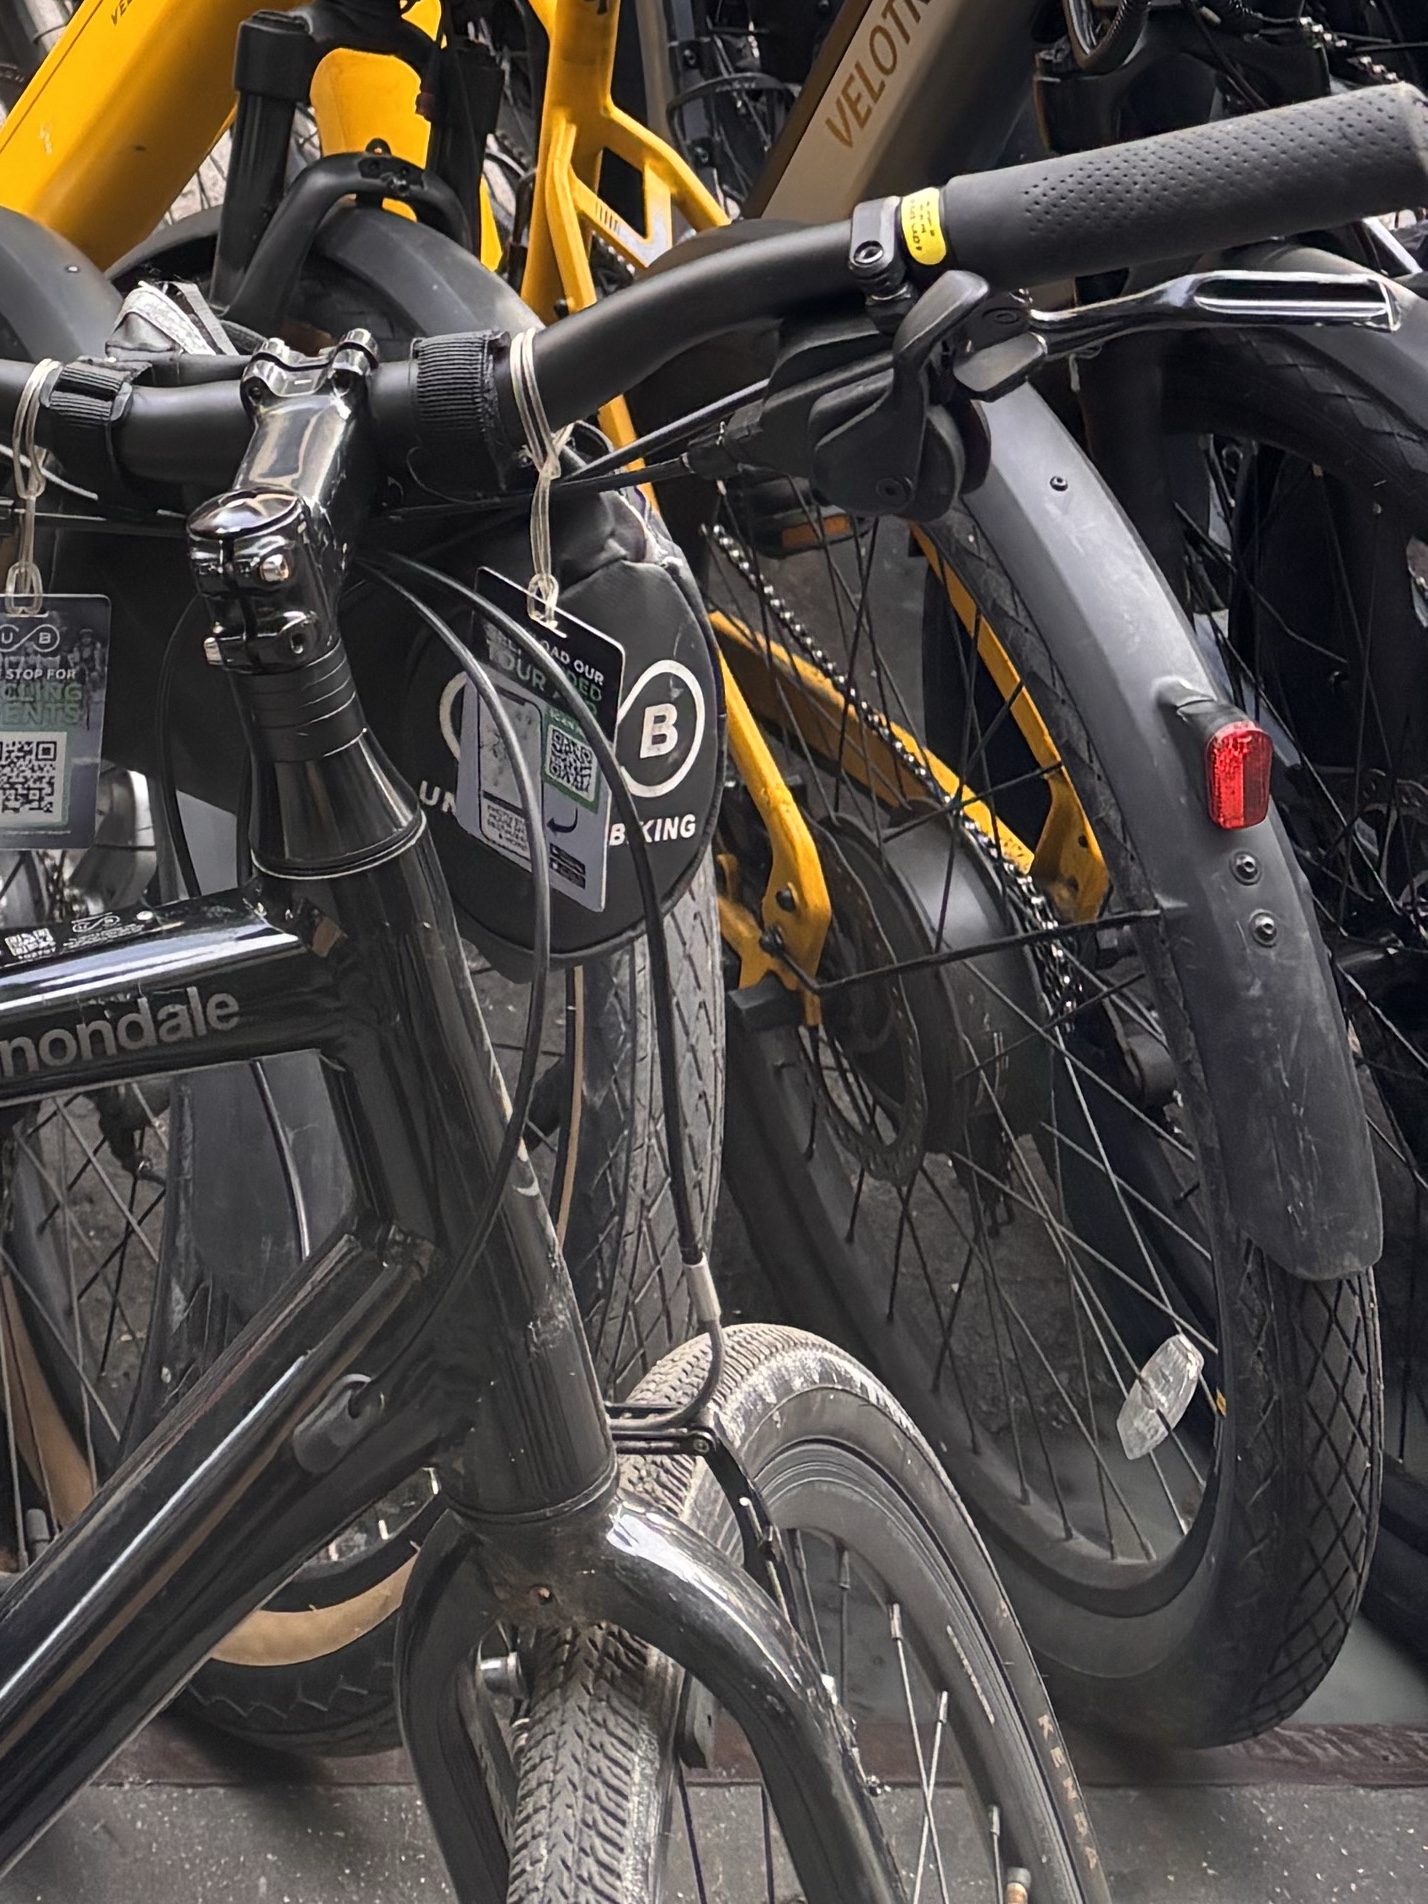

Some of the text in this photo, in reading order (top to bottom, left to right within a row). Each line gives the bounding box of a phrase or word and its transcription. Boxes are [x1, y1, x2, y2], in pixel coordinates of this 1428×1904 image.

[5, 668, 43, 680] STOP
[47, 668, 77, 680] FOR
[573, 658, 605, 687] OUR
[639, 702, 679, 759] B
[608, 813, 696, 847] BKING
[1037, 1714, 1097, 1871] KENDA
